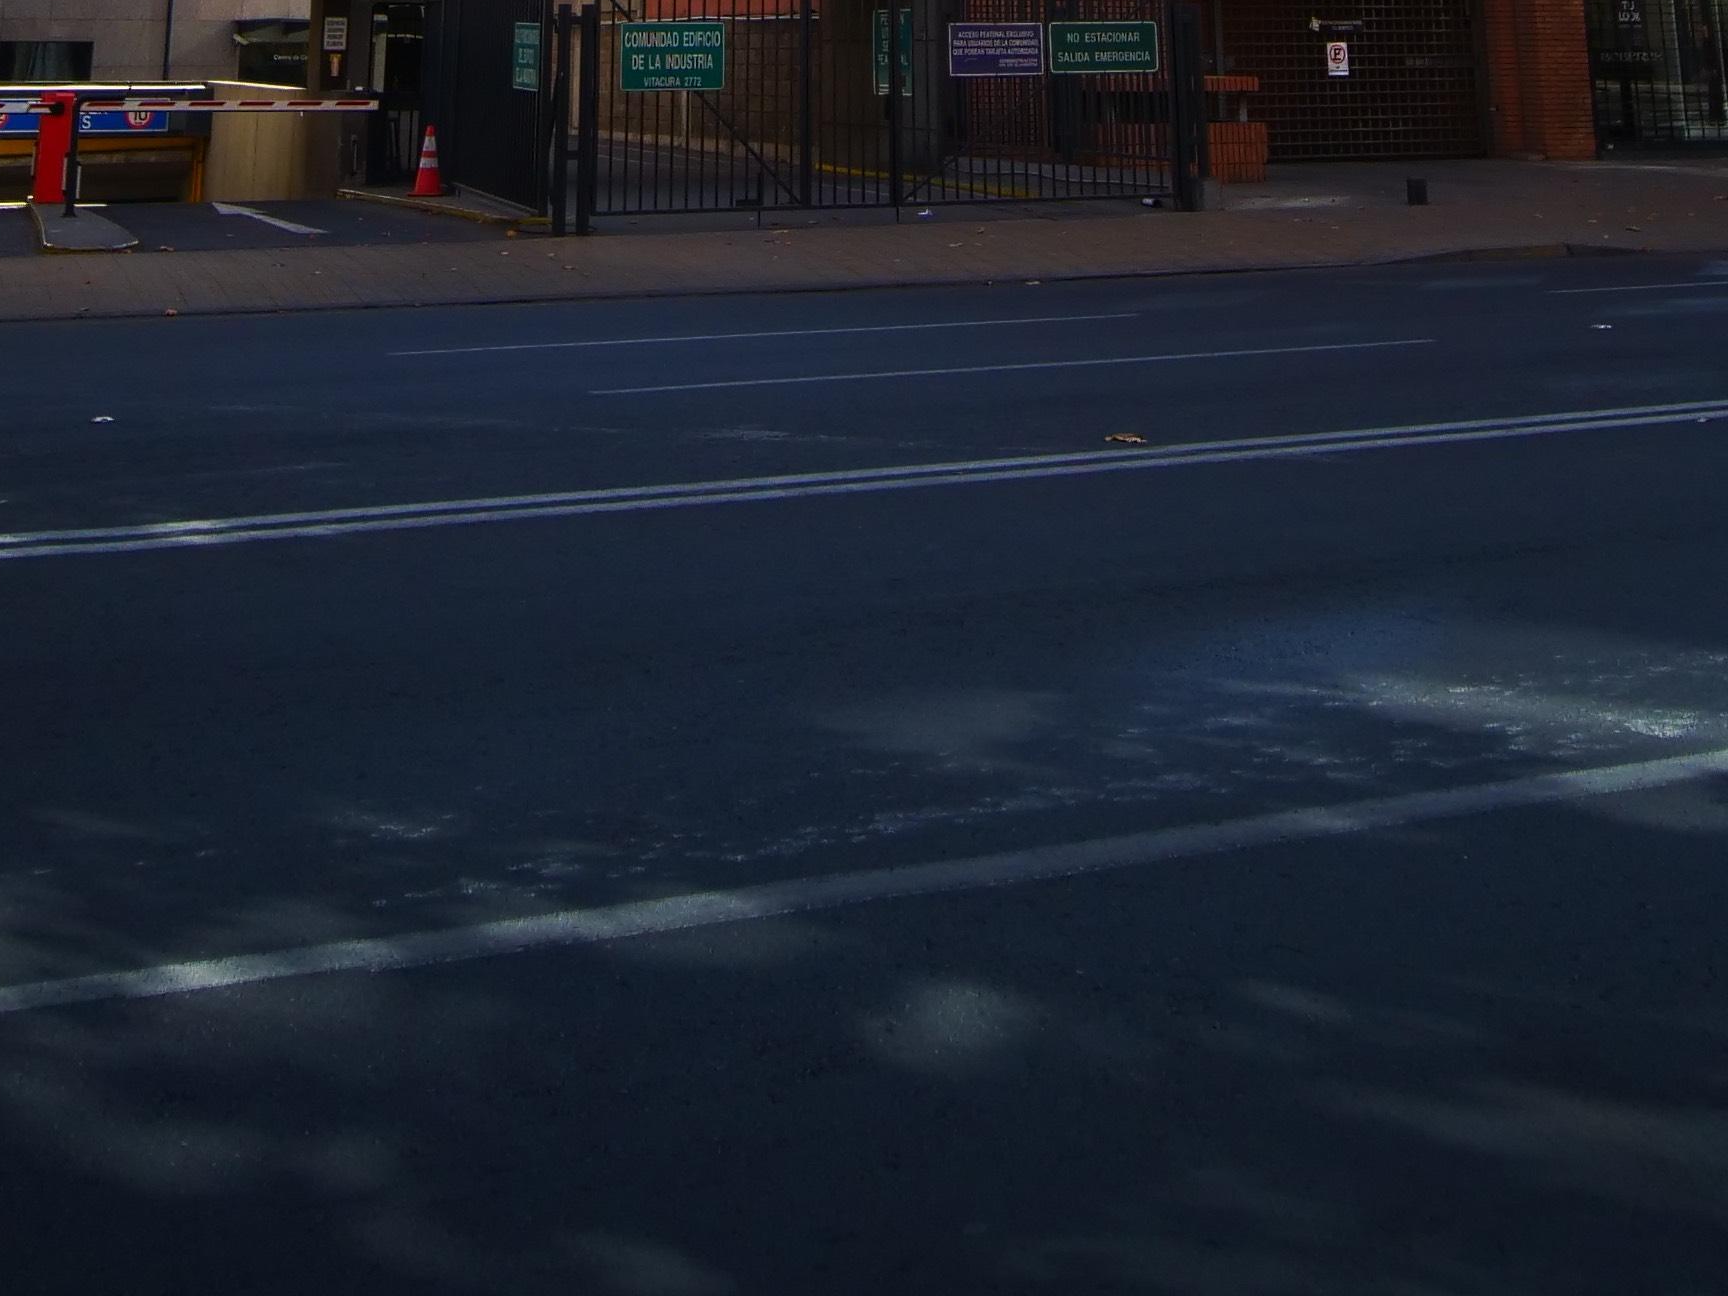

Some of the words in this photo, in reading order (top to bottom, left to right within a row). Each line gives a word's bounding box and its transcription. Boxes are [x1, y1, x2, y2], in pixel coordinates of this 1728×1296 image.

[624, 31, 680, 48] COMUNIDAD
[683, 31, 722, 48] EDIFICIO
[1067, 32, 1080, 44] NO
[1084, 32, 1141, 44] ESTACIONAR
[631, 53, 645, 71] DE
[648, 53, 662, 71] LA
[665, 53, 714, 71] INDUSTRIA
[1057, 51, 1090, 63] SALIDA
[1095, 50, 1152, 63] EMERGENCIA
[643, 76, 681, 88] VITACURA
[684, 76, 703, 88] 2772
